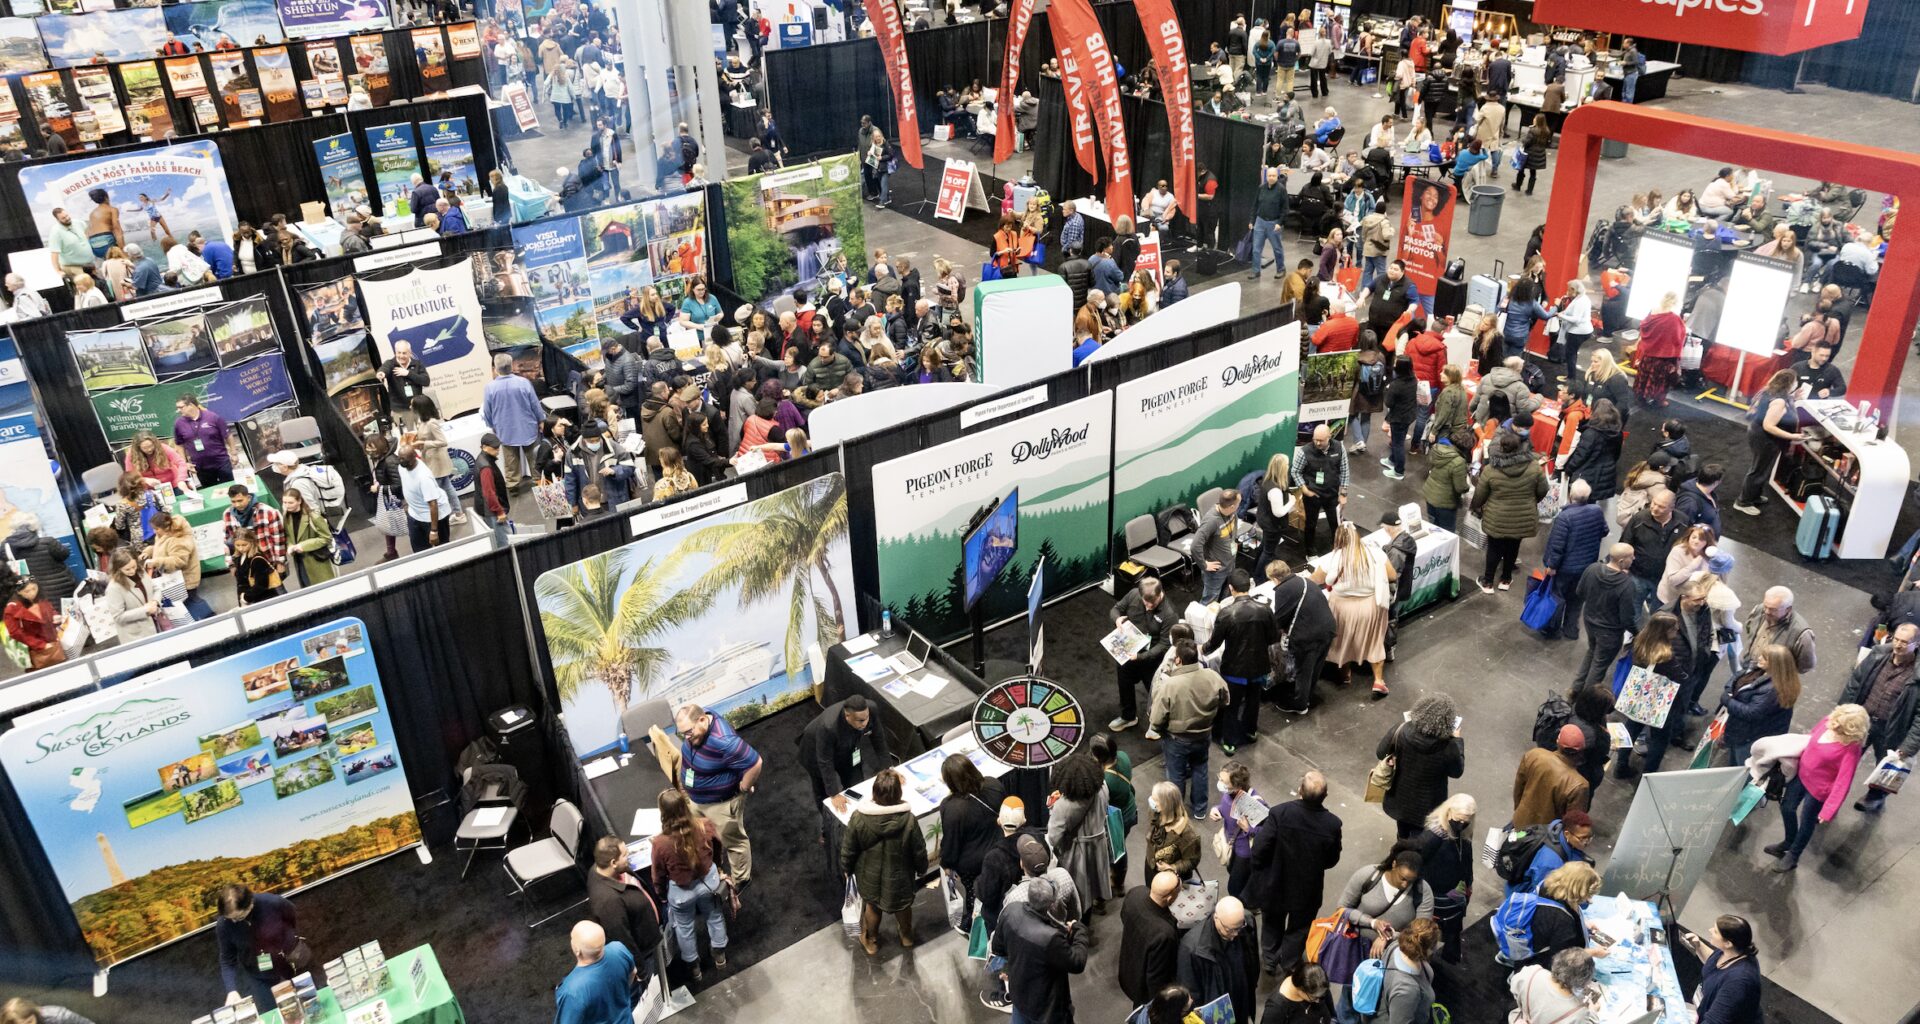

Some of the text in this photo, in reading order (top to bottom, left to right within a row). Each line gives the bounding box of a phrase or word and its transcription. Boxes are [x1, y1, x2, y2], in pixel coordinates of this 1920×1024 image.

[284, 4, 315, 15] SHEN
[316, 3, 339, 12] YUN
[180, 71, 199, 81] BEST
[896, 39, 915, 122] TRAVEL
[1160, 18, 1193, 166] TRAVEL HUB
[1085, 31, 1129, 183] TRAVEL HUB
[83, 163, 132, 178] DAYTONA
[383, 160, 411, 172] Outside
[63, 165, 202, 196] WORLD'S MOST FAMOUS BEACH
[524, 240, 545, 251] UCKS
[545, 233, 577, 246] COUNTY
[535, 230, 558, 241] VISIT
[1404, 235, 1444, 252] PASSPORT
[1645, 229, 1694, 247] PASSPORT PHOTOS
[1137, 252, 1157, 264] OFF
[1403, 243, 1435, 259] PHOTOS
[1739, 254, 1794, 270] PASSPORT PHOTOS
[391, 296, 456, 321] ADVENTURE
[240, 361, 270, 377] CLOSE TO
[261, 368, 273, 376] YET
[245, 376, 272, 390] WORLDS
[252, 384, 269, 396] AWAY
[1141, 376, 1208, 412] PIGEON FORGE
[1144, 391, 1205, 419] TENNESSEE
[106, 412, 159, 423] Wilmington
[110, 421, 160, 432] Brandywine
[905, 452, 994, 495] PIGEON FORGE
[911, 469, 990, 502] TENNESSEE
[660, 508, 680, 519] Vacation
[685, 503, 699, 513] Travel
[699, 499, 713, 509] Group
[713, 496, 721, 504] LLC
[88, 711, 192, 753] SKYLANDS
[25, 720, 112, 764] Sussex
